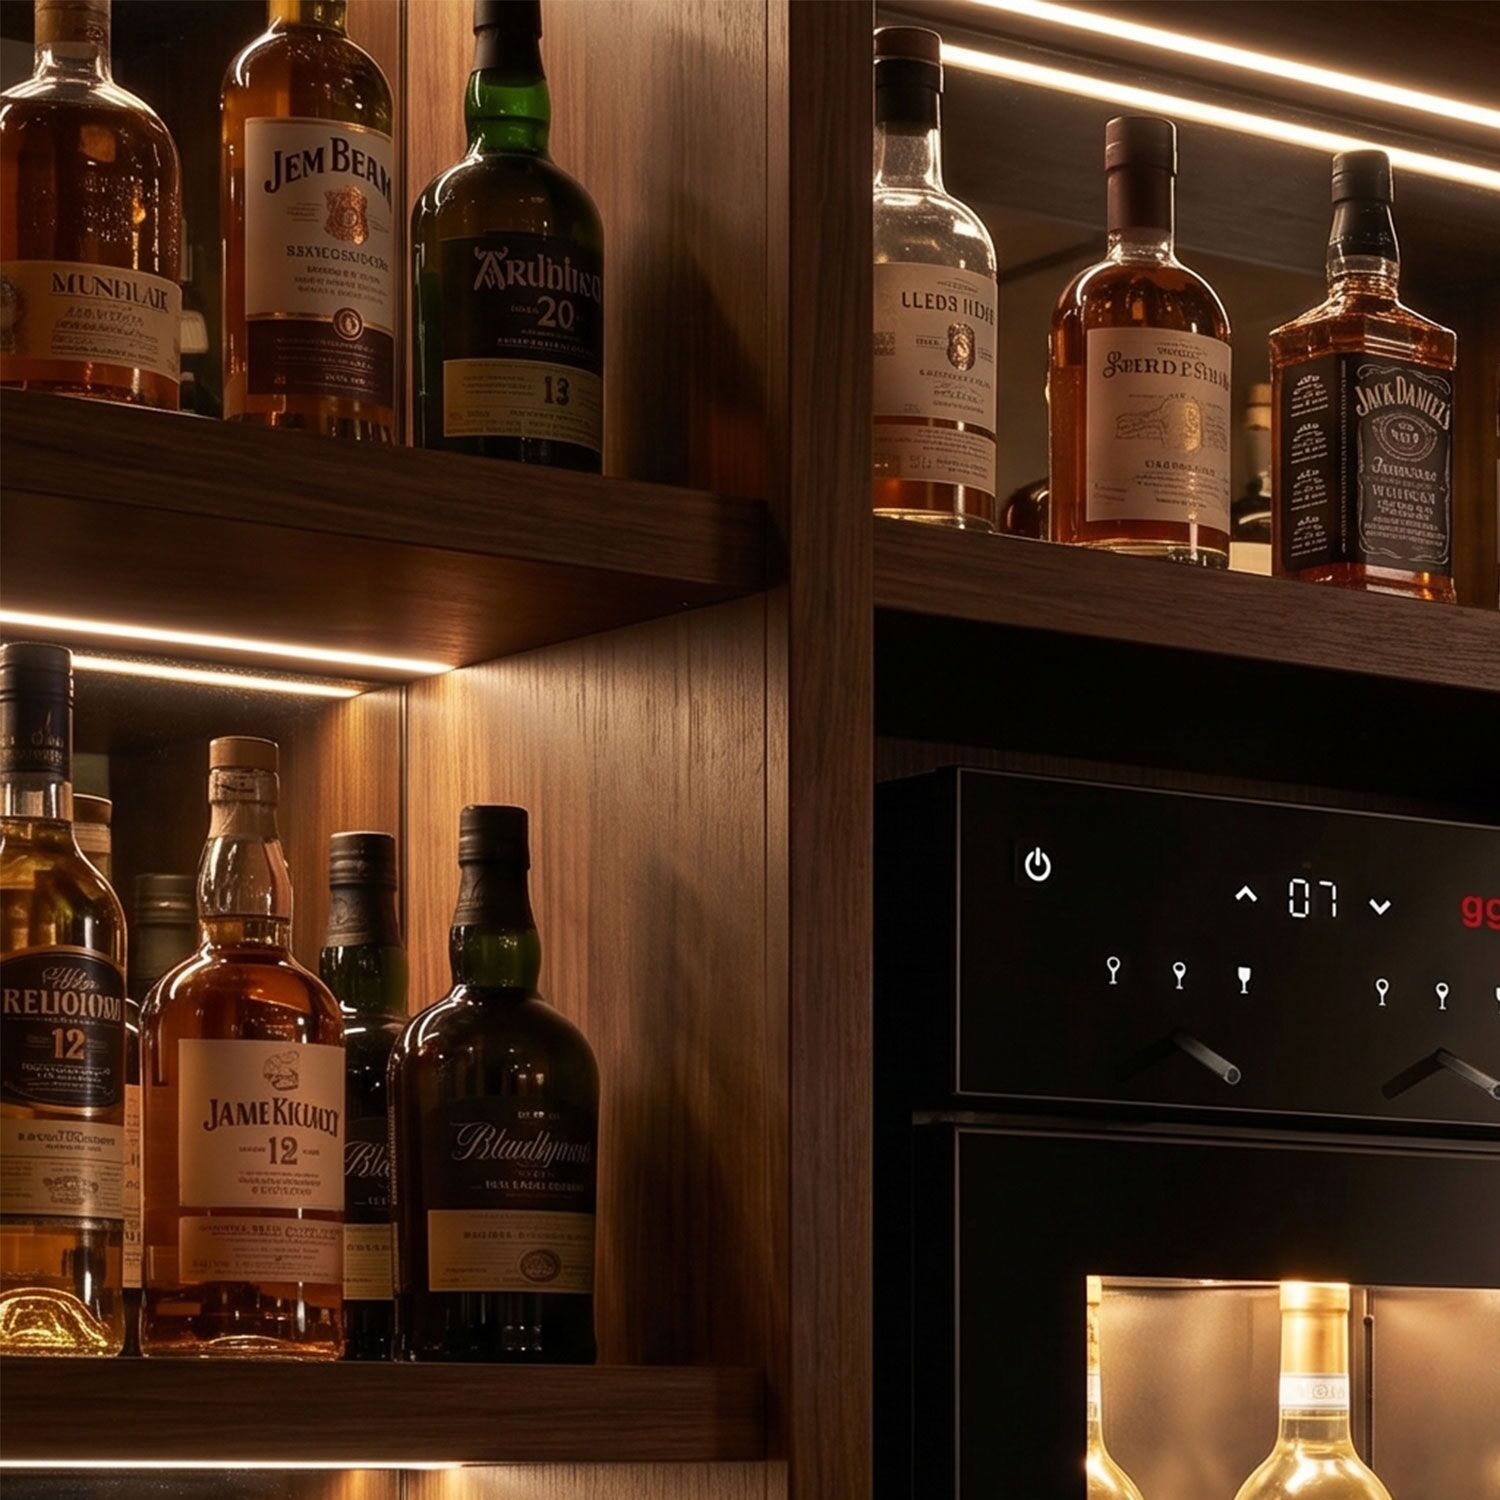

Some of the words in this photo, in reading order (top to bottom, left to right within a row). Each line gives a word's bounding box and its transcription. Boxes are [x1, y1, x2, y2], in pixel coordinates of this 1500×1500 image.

[537, 295, 575, 330] 20
[1289, 878, 1337, 918] 07
[52, 1028, 86, 1060] 12
[268, 1136, 298, 1165] 12
